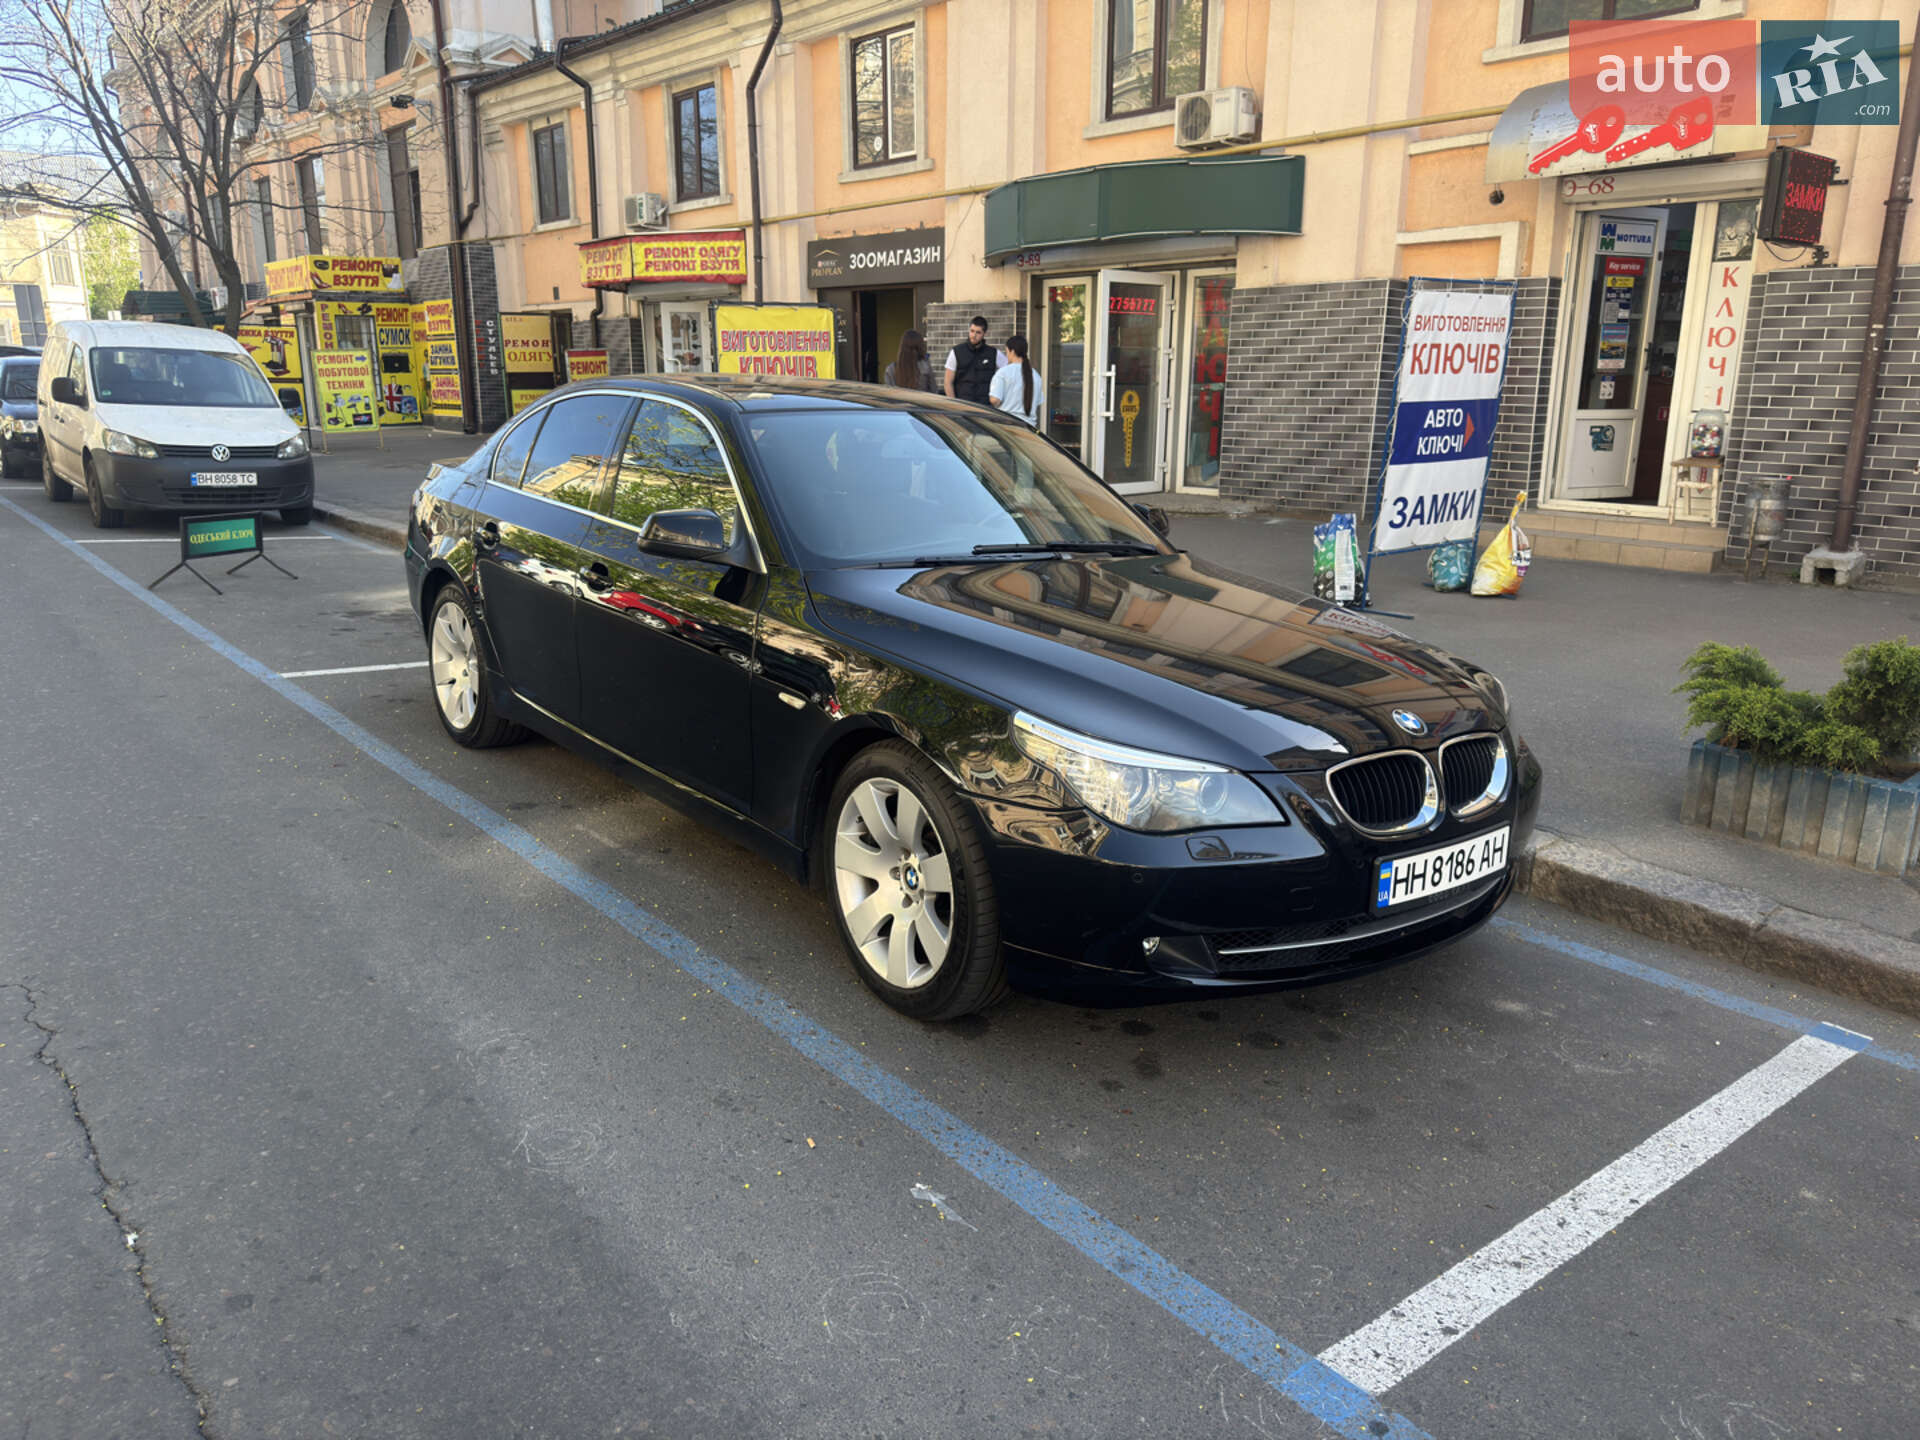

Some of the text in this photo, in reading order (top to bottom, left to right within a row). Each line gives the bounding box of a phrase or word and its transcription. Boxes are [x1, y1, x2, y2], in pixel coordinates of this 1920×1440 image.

[1785, 182, 1825, 212] ЗАМКИ
[1616, 234, 1652, 244] MOTTURA
[586, 247, 624, 264] РЕМОНТ
[644, 247, 697, 259] РЕМОНТ
[849, 246, 941, 269] ЗООМАГАЗИН
[331, 259, 382, 272] РЕМОНТ
[645, 260, 697, 272] РЕМОНТ
[333, 275, 379, 287] ВЗУТТЯ
[376, 307, 409, 323] РЕМОНТ
[1414, 314, 1506, 333] ВИГОТОВЛЕННЯ
[320, 303, 333, 349] РЕМОН
[379, 327, 411, 345] СУМОК
[504, 339, 552, 348] РЕМОН
[720, 330, 831, 352] ВИГОТОВЛЕННЯ
[1707, 266, 1740, 406] КЛЮЧІ
[316, 354, 353, 365] РЕМОНТ
[738, 356, 817, 378] КЛЮЧІВ
[1410, 342, 1501, 375] КЛЮЧІВ
[318, 364, 369, 377] ПОБУТОВОЇ
[570, 360, 607, 375] РЕМОНТ
[326, 380, 365, 390] ТЕХНІКИ
[1424, 408, 1463, 429] АВТО
[1416, 434, 1463, 455] КЛЮЧІ
[215, 474, 237, 484] 8058
[1388, 489, 1477, 529] ЗАМКИ
[1392, 833, 1505, 898] HH 8186 AH
[1378, 892, 1389, 901] UA
